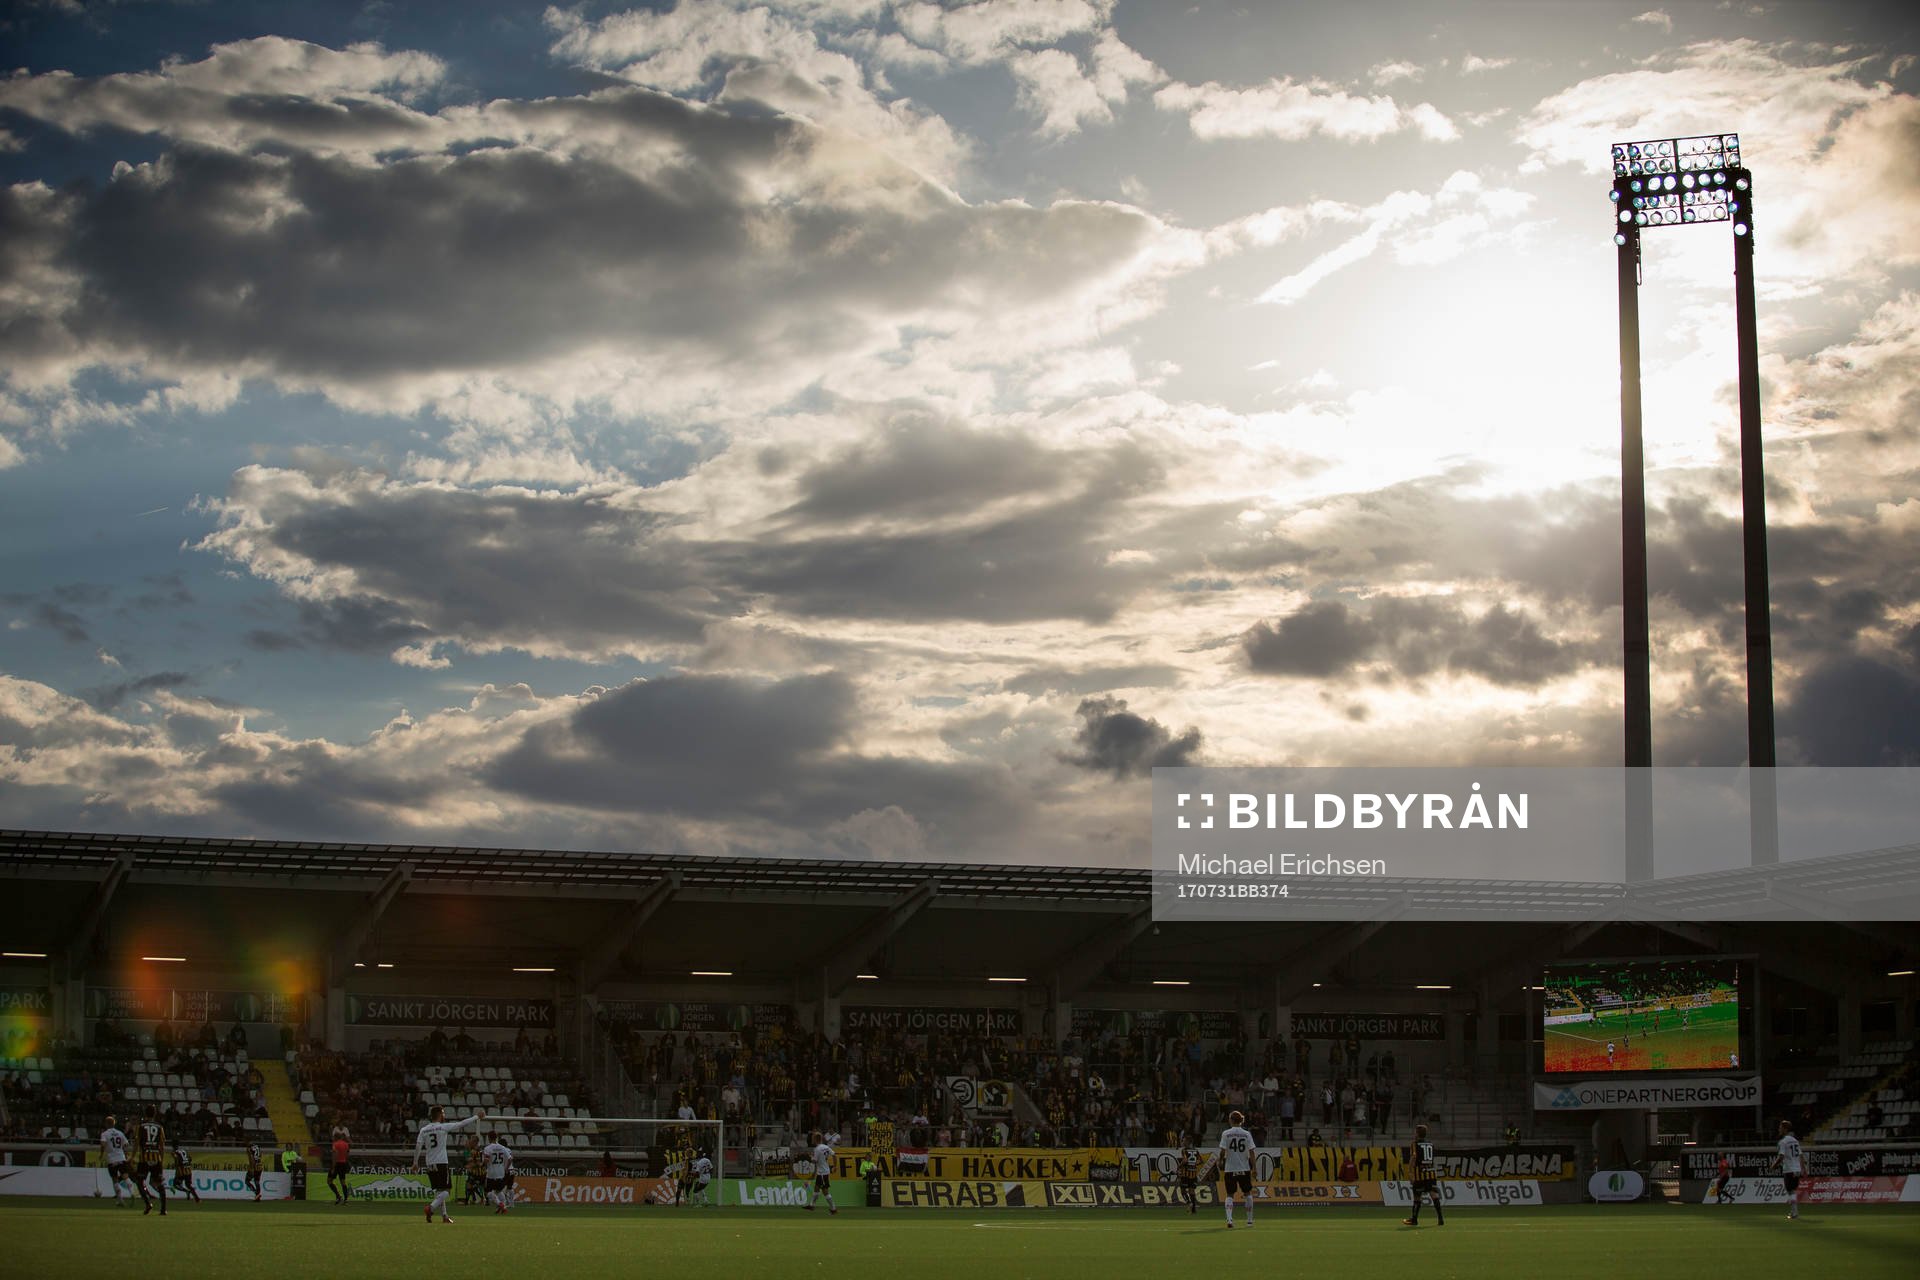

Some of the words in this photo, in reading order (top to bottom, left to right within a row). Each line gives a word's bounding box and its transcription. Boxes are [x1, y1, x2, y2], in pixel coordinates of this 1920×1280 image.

[367, 1002, 424, 1019] SANKT
[428, 1000, 498, 1021] JÖRGEN
[506, 1005, 549, 1022] PARK
[849, 1012, 901, 1028] SANKT
[976, 1013, 1016, 1029] PARK
[1290, 1018, 1336, 1033] SANKT
[1338, 1016, 1398, 1034] JÖRGEN
[1403, 1019, 1440, 1034] PARK
[1580, 1086, 1757, 1105] ONEPARTNERGROUP
[110, 1136, 122, 1149] 19
[429, 1133, 438, 1148] 3
[1229, 1137, 1246, 1153] 46
[492, 1152, 504, 1165] 25
[1421, 1144, 1433, 1161] 10
[1790, 1144, 1800, 1157] 15
[963, 1151, 1068, 1178] HÄCKEN
[1432, 1154, 1562, 1178] ETINGARNA
[1689, 1153, 1736, 1169] REKLM
[348, 1183, 434, 1201] Ångtvättbile
[545, 1179, 634, 1204] Renova
[739, 1180, 808, 1206] Lendo
[892, 1182, 998, 1206] EHRAB
[1055, 1186, 1093, 1203] XL
[1099, 1185, 1213, 1204] XL-BYG
[1274, 1187, 1329, 1198] HECO
[1476, 1180, 1534, 1205] higab
